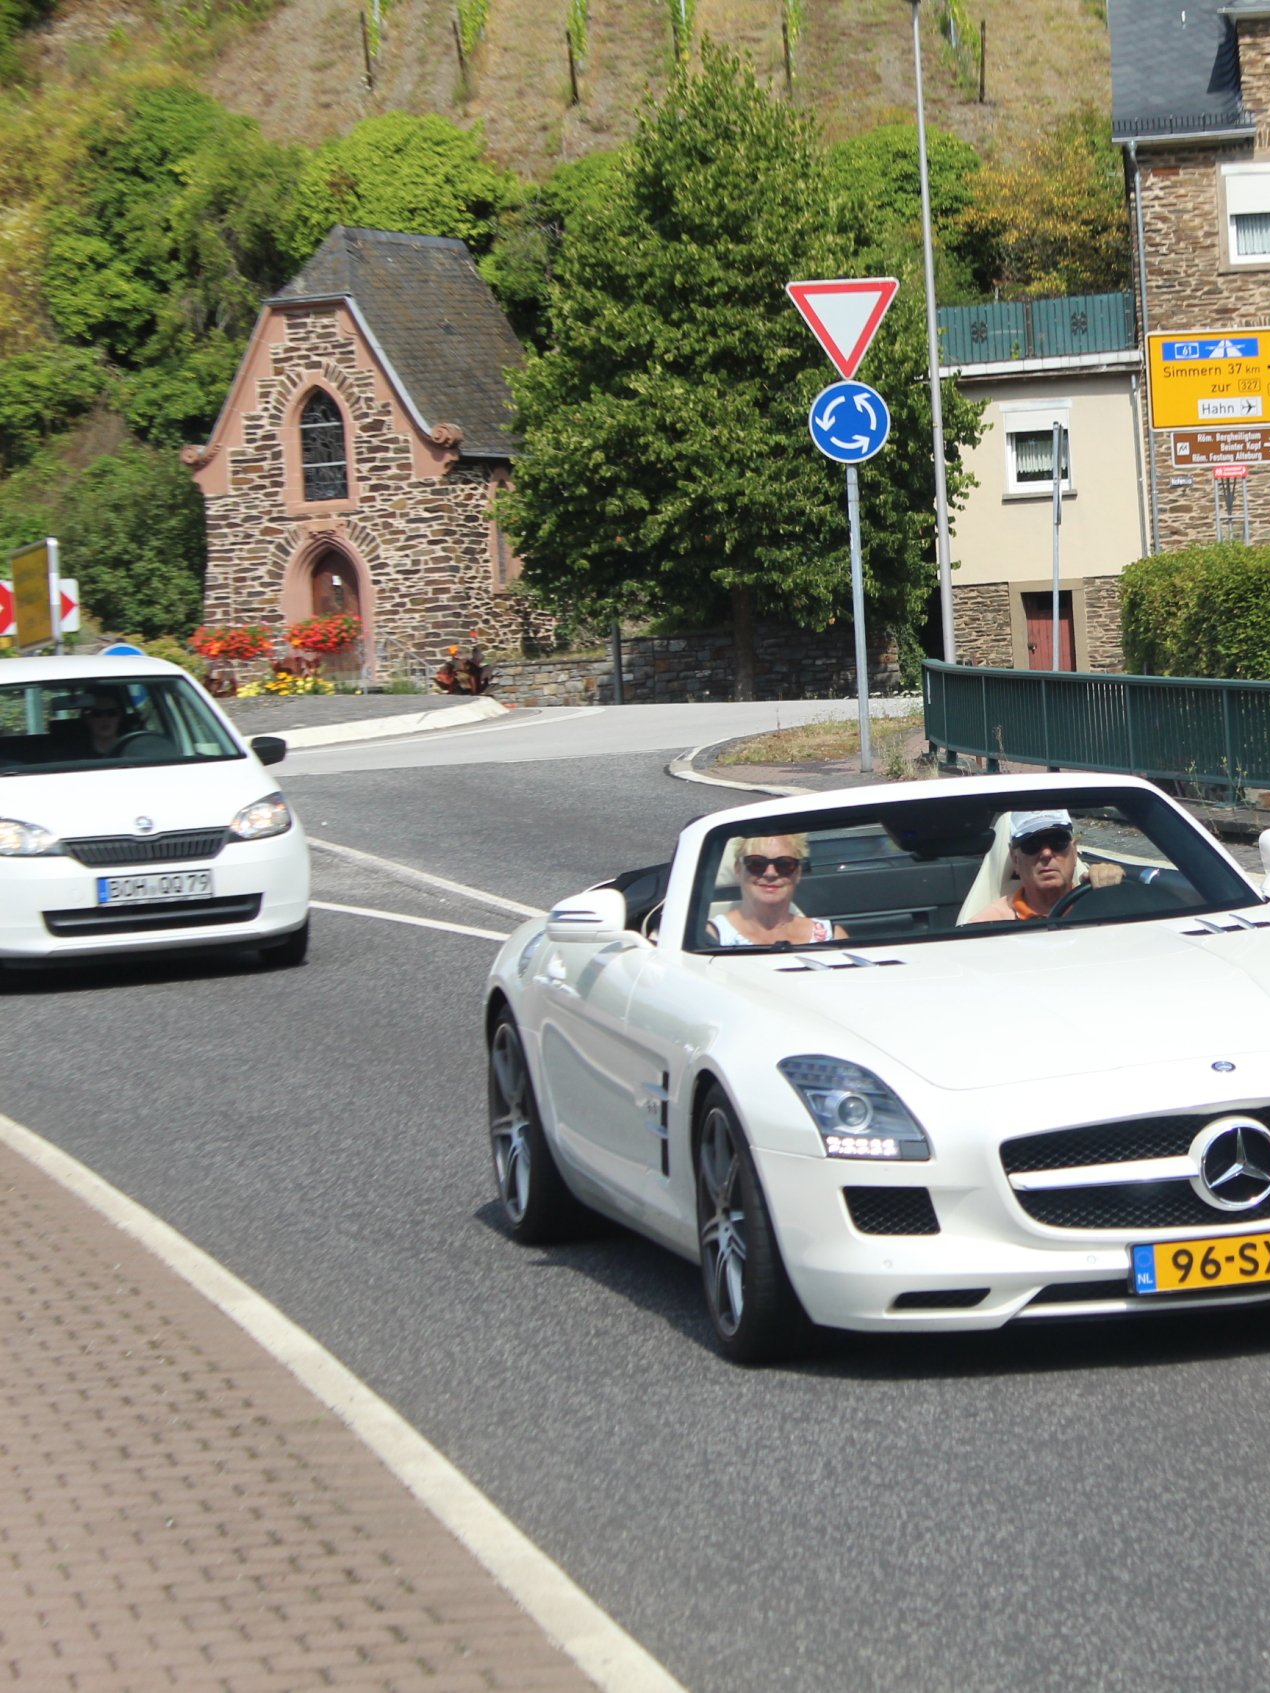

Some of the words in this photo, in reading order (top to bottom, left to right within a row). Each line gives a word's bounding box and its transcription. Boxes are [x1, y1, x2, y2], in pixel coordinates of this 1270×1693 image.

[1182, 345, 1192, 356] 61
[1163, 365, 1222, 378] Simmern
[1227, 363, 1242, 375] 37
[1246, 365, 1260, 374] km
[1211, 383, 1231, 393] zur
[1241, 380, 1258, 390] 327
[1202, 403, 1234, 415] Hahn
[1197, 434, 1214, 443] Röm.
[1216, 432, 1261, 443] Bergheiligtum
[1246, 441, 1262, 451] Kopf
[1192, 454, 1208, 462] Röm.
[1209, 453, 1234, 462] Festung
[1236, 451, 1262, 460] Alteburg
[108, 879, 147, 898] BOH
[1137, 1272, 1153, 1285] NL
